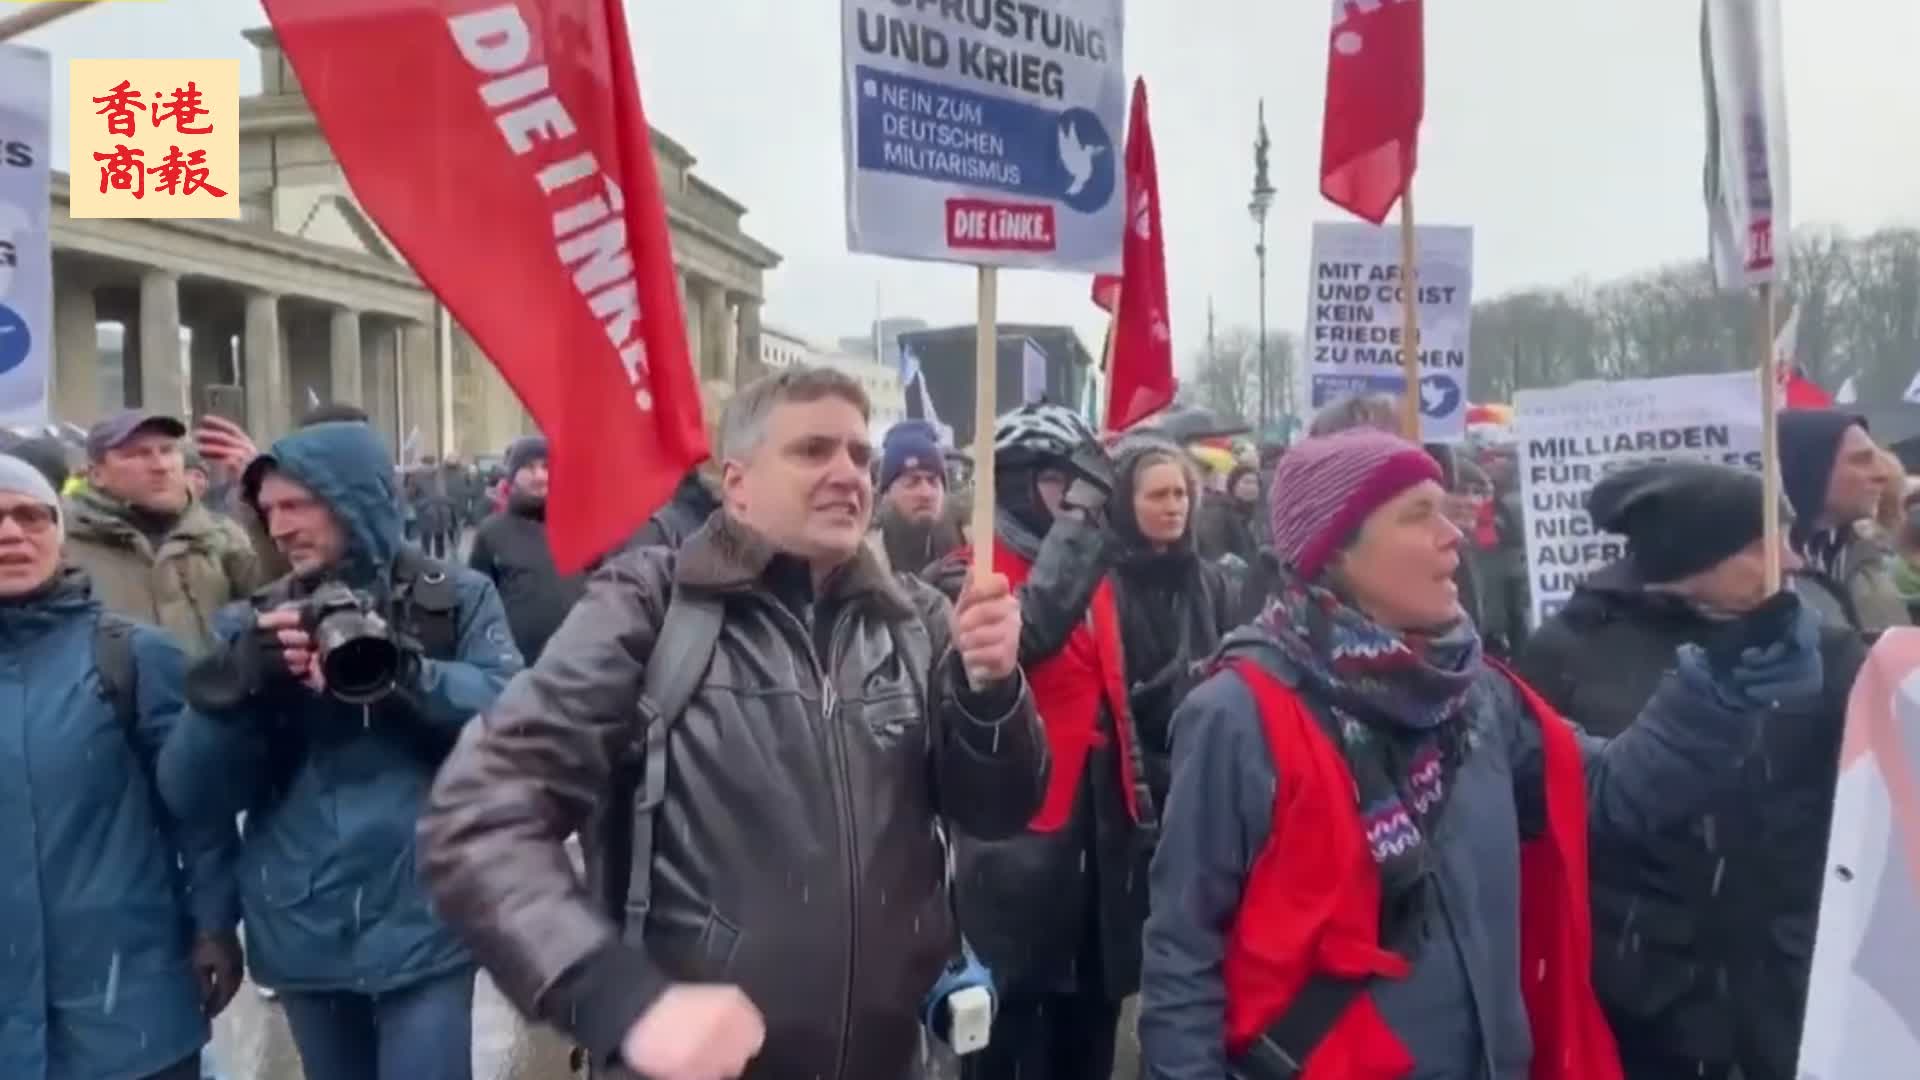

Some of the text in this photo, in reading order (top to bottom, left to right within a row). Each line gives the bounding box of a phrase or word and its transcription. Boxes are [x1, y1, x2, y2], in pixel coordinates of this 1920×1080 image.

[856, 7, 1064, 101] UND KRIEG
[446, 4, 578, 156] DIE
[881, 83, 983, 125] NEIN ZUM
[882, 112, 1005, 157] DEUTSCHEN
[883, 142, 1022, 186] MILITARISMUS
[953, 207, 987, 239] DIE
[1318, 262, 1362, 281] MIT
[1317, 283, 1371, 302] UND
[1417, 285, 1457, 304] IST
[1315, 303, 1375, 323] KEIN
[1313, 345, 1349, 364] ZU
[1528, 424, 1730, 459] MILLIARDEN
